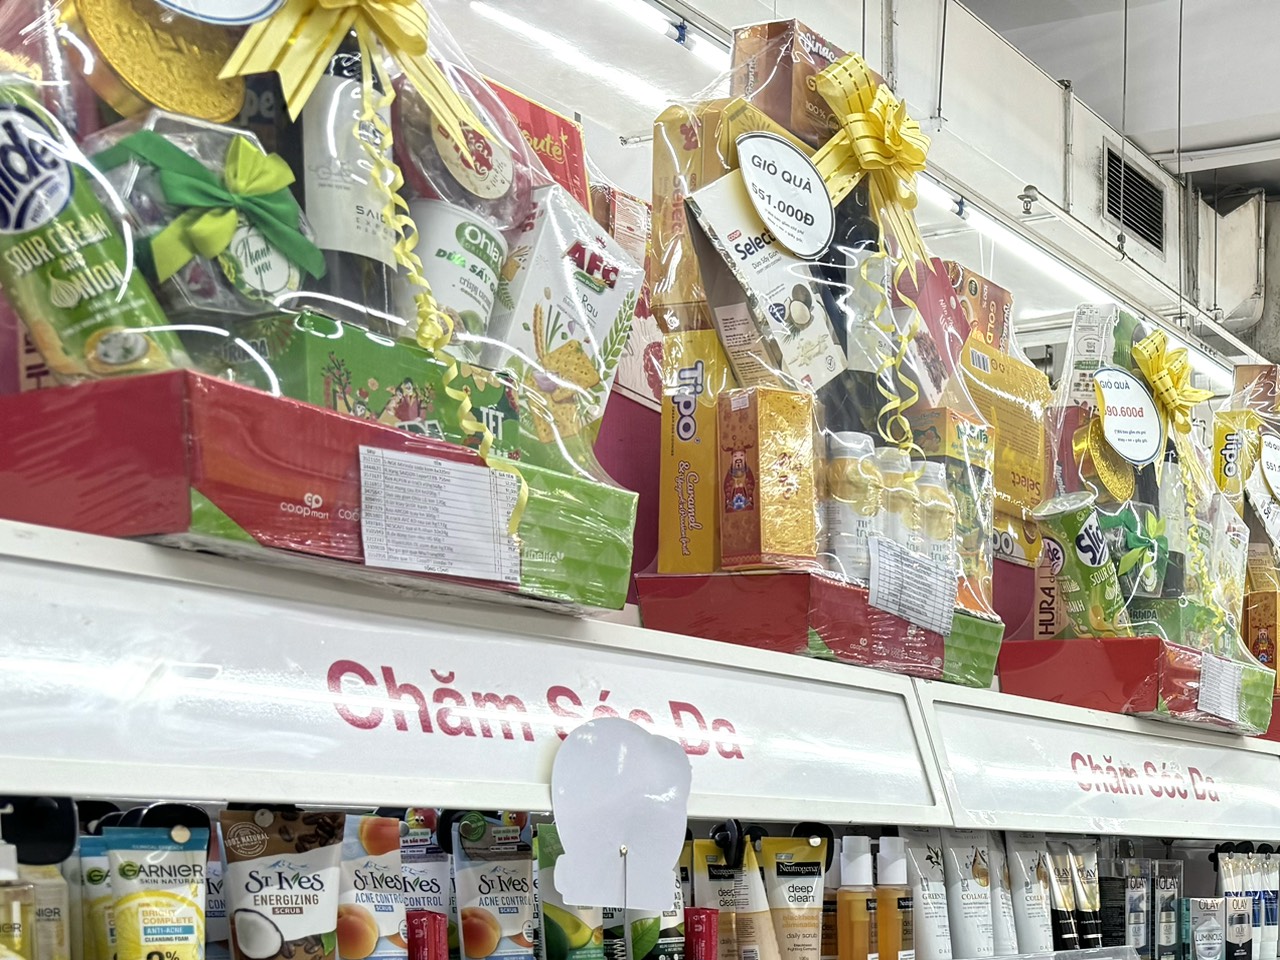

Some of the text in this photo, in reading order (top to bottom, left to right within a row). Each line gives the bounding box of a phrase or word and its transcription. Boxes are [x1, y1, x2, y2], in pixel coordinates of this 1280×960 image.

[751, 152, 813, 195] GIỎ QUÀ
[5, 235, 54, 275] SOUR
[236, 239, 272, 268] Thank
[253, 261, 273, 281] you
[1114, 378, 1131, 391] QUÀ
[1038, 584, 1056, 637] HURA
[327, 659, 535, 742] Chăm
[669, 700, 745, 760] Da
[1071, 751, 1220, 802] Chăm Sóc Da
[779, 863, 819, 874] Neutrogena
[788, 884, 813, 896] deep
[253, 894, 319, 906] ENERGIZING
[355, 894, 374, 904] ACNE
[403, 897, 443, 907] CONTROL
[479, 897, 499, 906] ACNE
[788, 893, 815, 903] clean
[1199, 900, 1220, 911] OLAY
[1232, 899, 1247, 909] OLAY
[273, 907, 302, 915] SCRUB
[142, 916, 193, 925] COMPLETE
[146, 926, 183, 935] ANTI-ACNE
